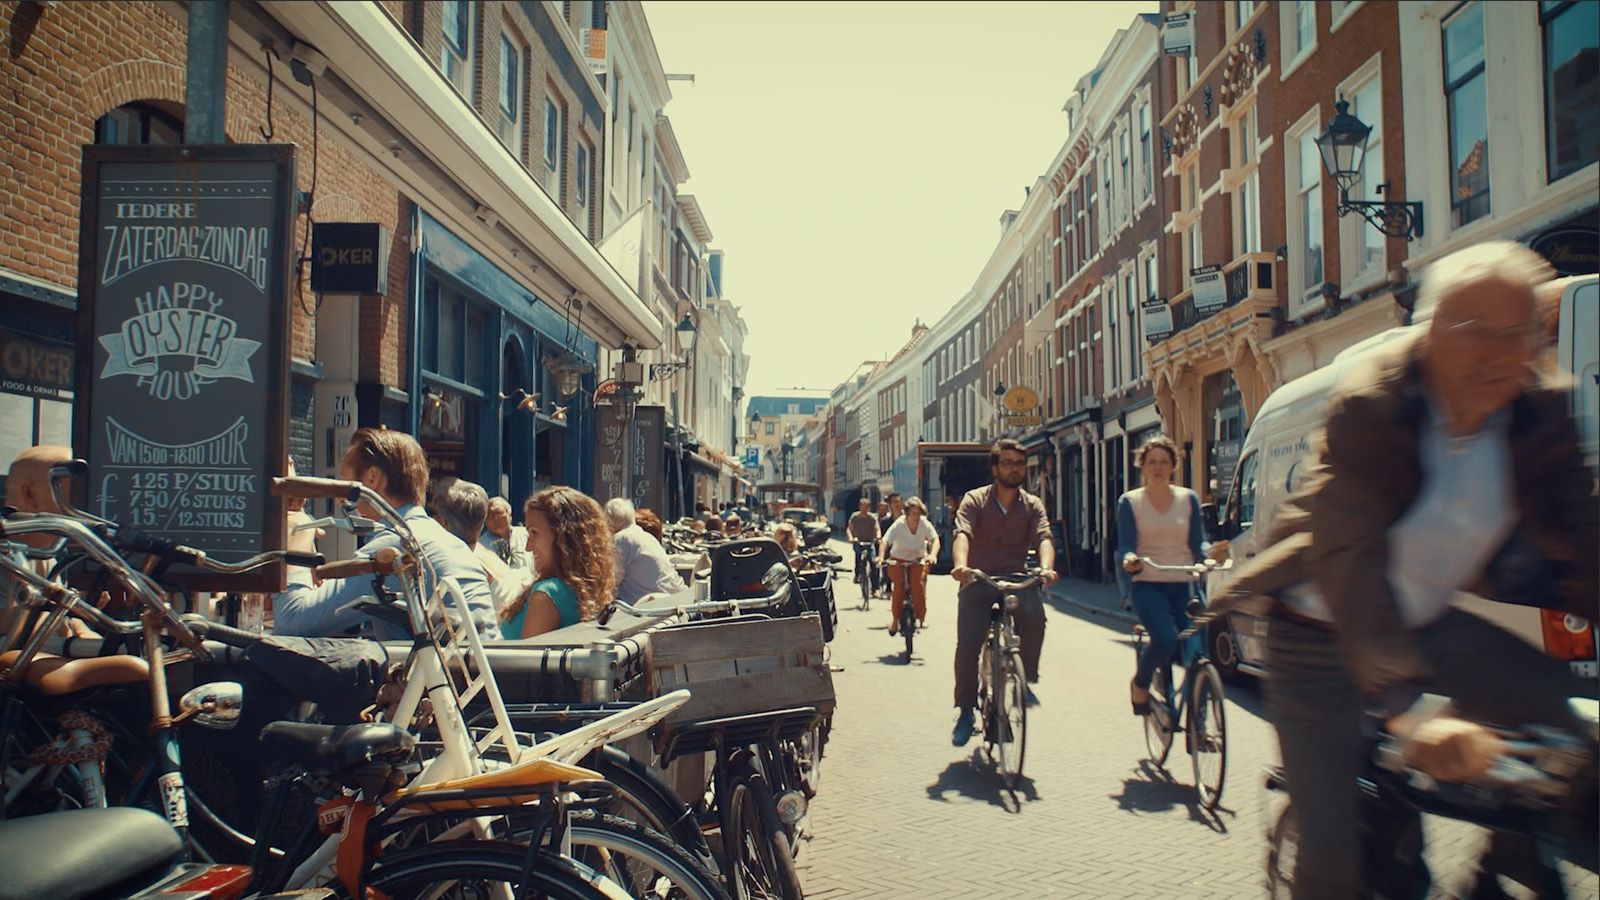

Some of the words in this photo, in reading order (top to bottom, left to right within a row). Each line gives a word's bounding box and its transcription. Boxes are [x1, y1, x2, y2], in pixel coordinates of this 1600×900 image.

[116, 203, 197, 219] IEDERE
[102, 226, 199, 285] ZATERDAG
[200, 226, 268, 289] ZONDAG
[319, 247, 374, 268] OKER
[135, 282, 224, 316] HAPPY
[128, 310, 233, 361] OYSTER
[2, 341, 71, 385] OKER
[3, 380, 25, 392] FOOD
[26, 383, 32, 392] &
[33, 385, 58, 396] DRINKS
[105, 421, 137, 464] VAN
[209, 422, 249, 465] UUR
[193, 494, 246, 510] STUKS
[196, 511, 245, 528] STUKS
